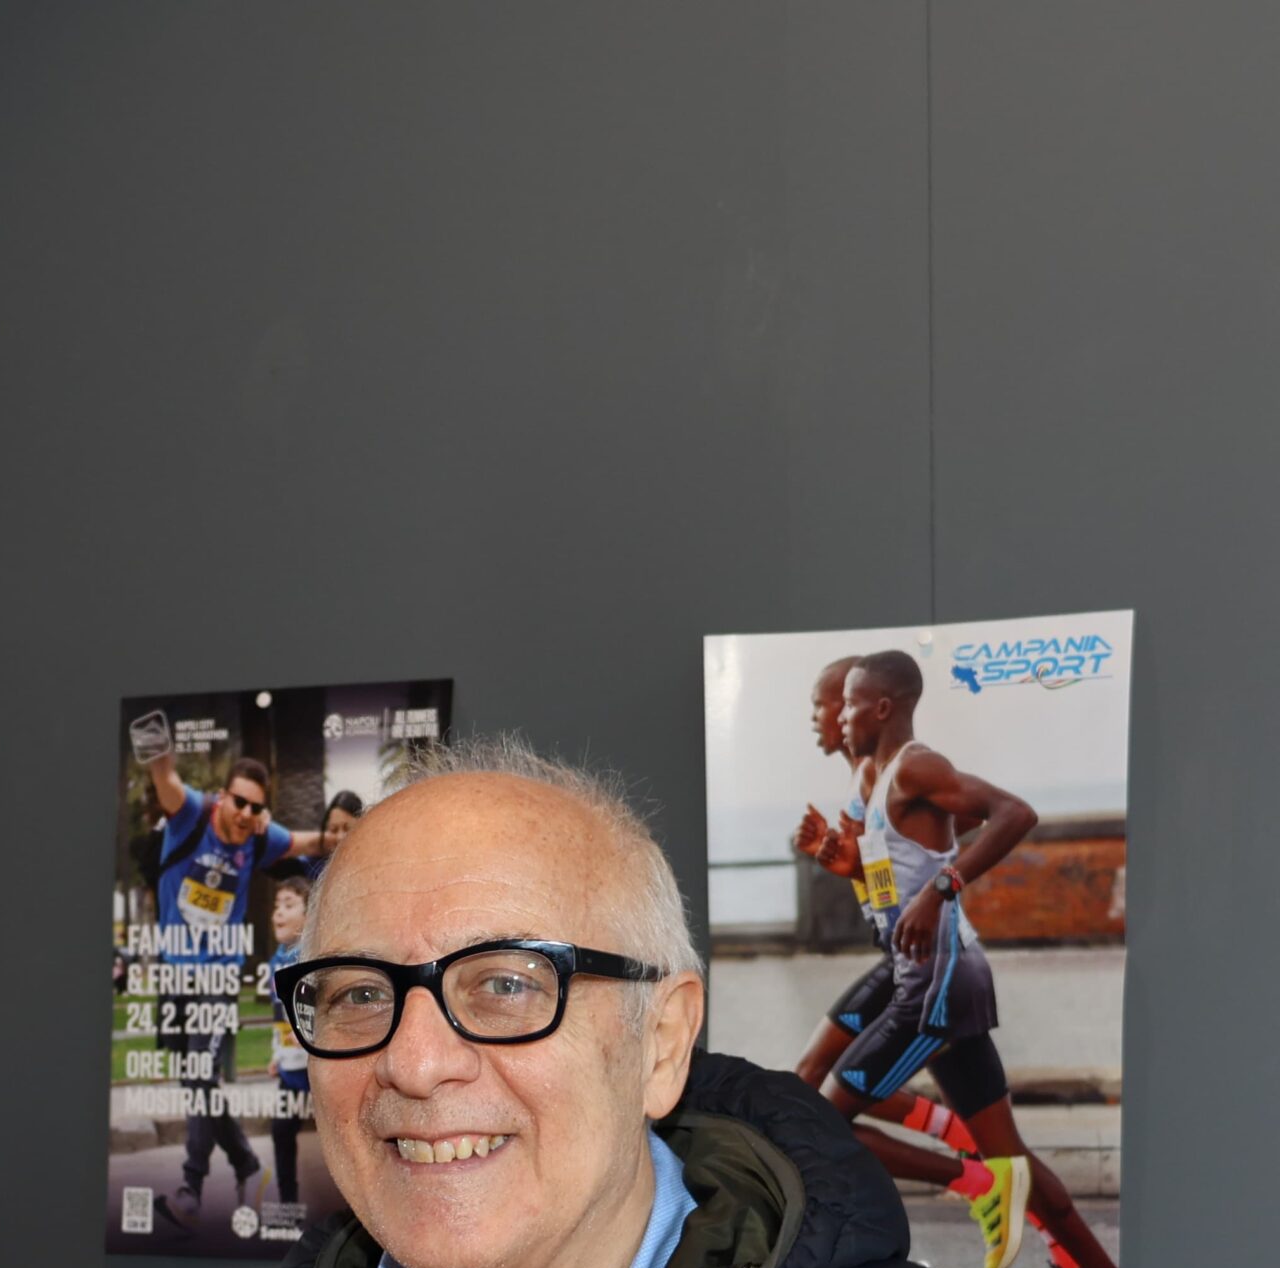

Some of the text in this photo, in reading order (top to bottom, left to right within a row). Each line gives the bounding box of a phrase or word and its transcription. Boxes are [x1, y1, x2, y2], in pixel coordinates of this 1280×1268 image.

[953, 634, 1113, 661] CAMPANIA
[981, 652, 1112, 682] SPORT
[128, 924, 254, 955] FAMILY RUN
[127, 963, 147, 993] &
[148, 963, 240, 995] FRIENDS
[127, 1003, 239, 1034] 24. 2. 2024
[126, 1052, 213, 1080] ORE 11:00
[125, 1087, 206, 1115] MOSTRA
